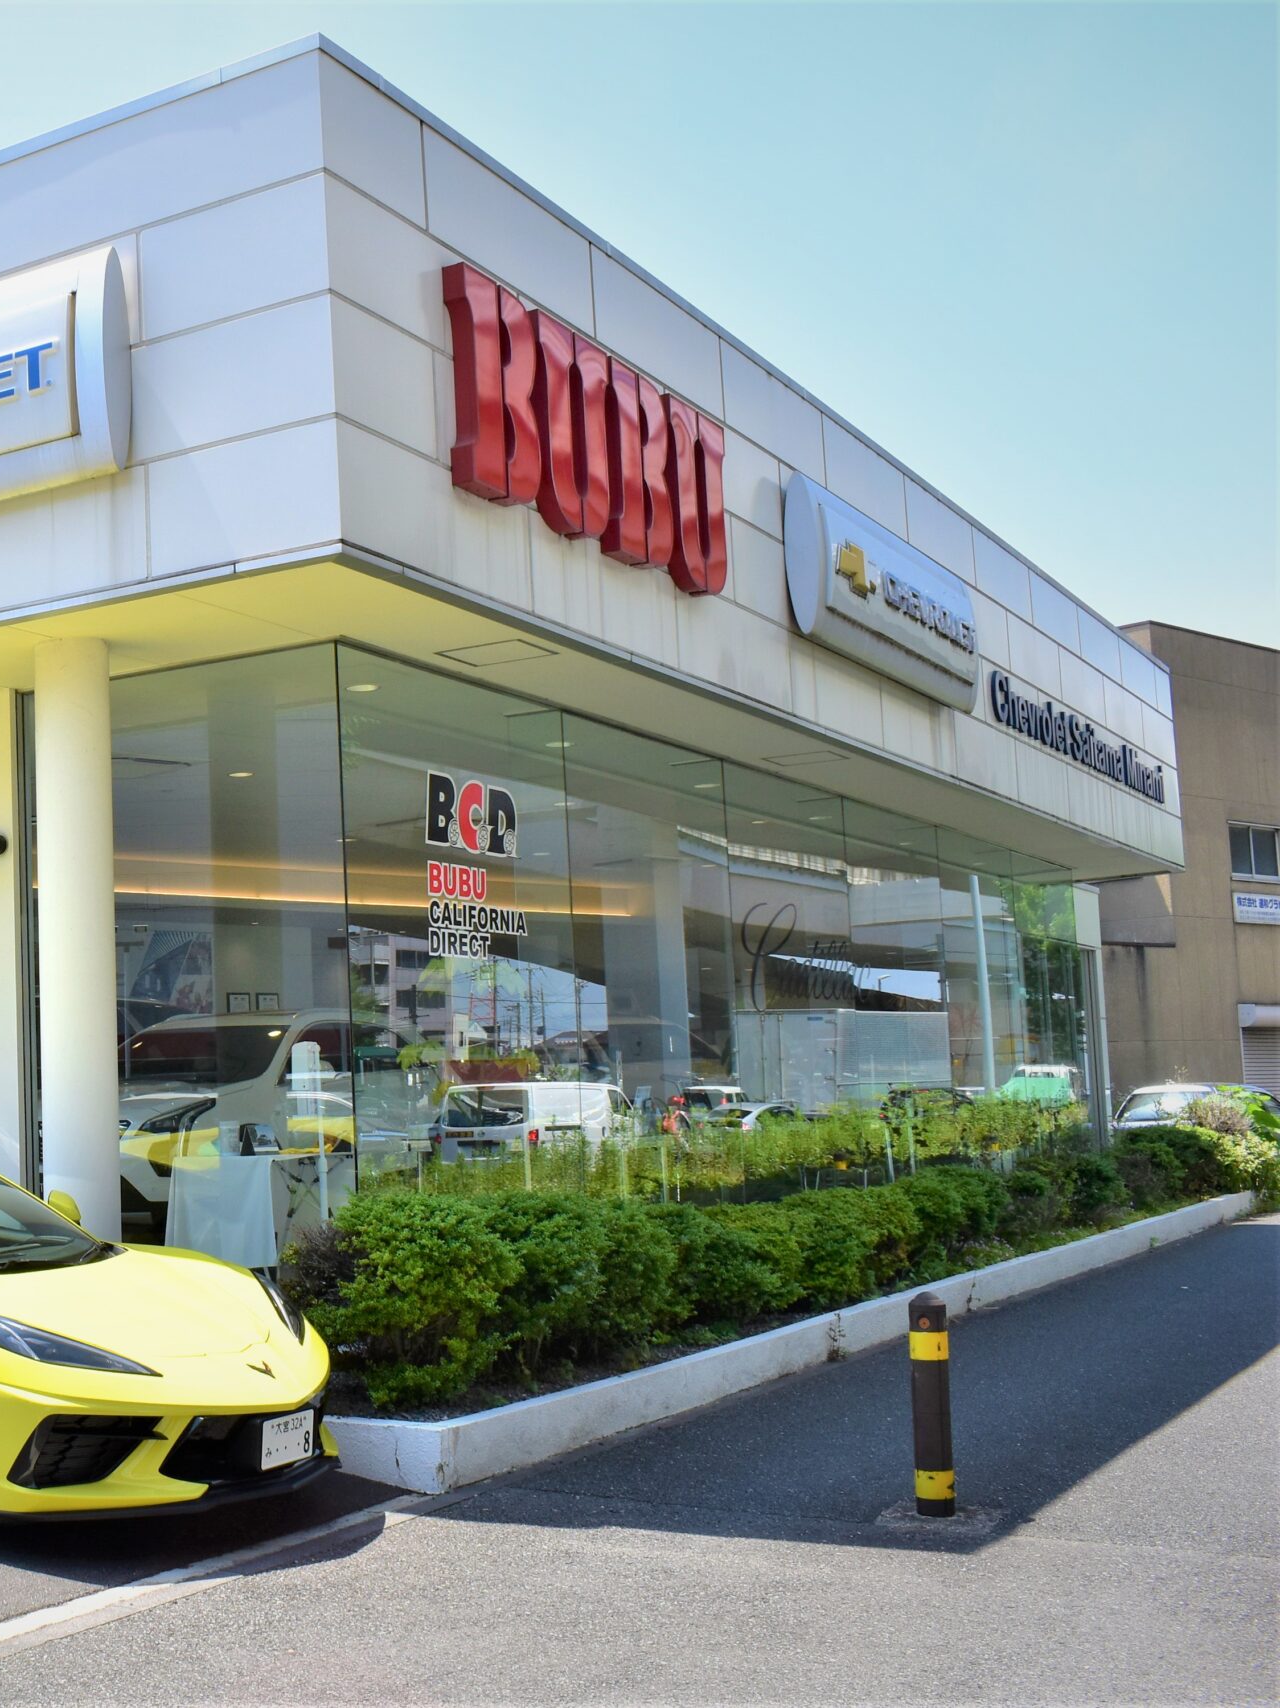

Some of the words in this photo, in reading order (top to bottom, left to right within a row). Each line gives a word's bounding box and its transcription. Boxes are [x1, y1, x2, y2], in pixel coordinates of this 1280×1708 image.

[442, 262, 726, 596] BUBU
[991, 670, 1068, 755] Chevrolet
[1069, 714, 1125, 783] Saitama
[1120, 744, 1165, 804] Minami
[427, 860, 487, 902] BUBU
[428, 897, 528, 936] CALIFORNIA
[428, 927, 490, 959] DIRECT
